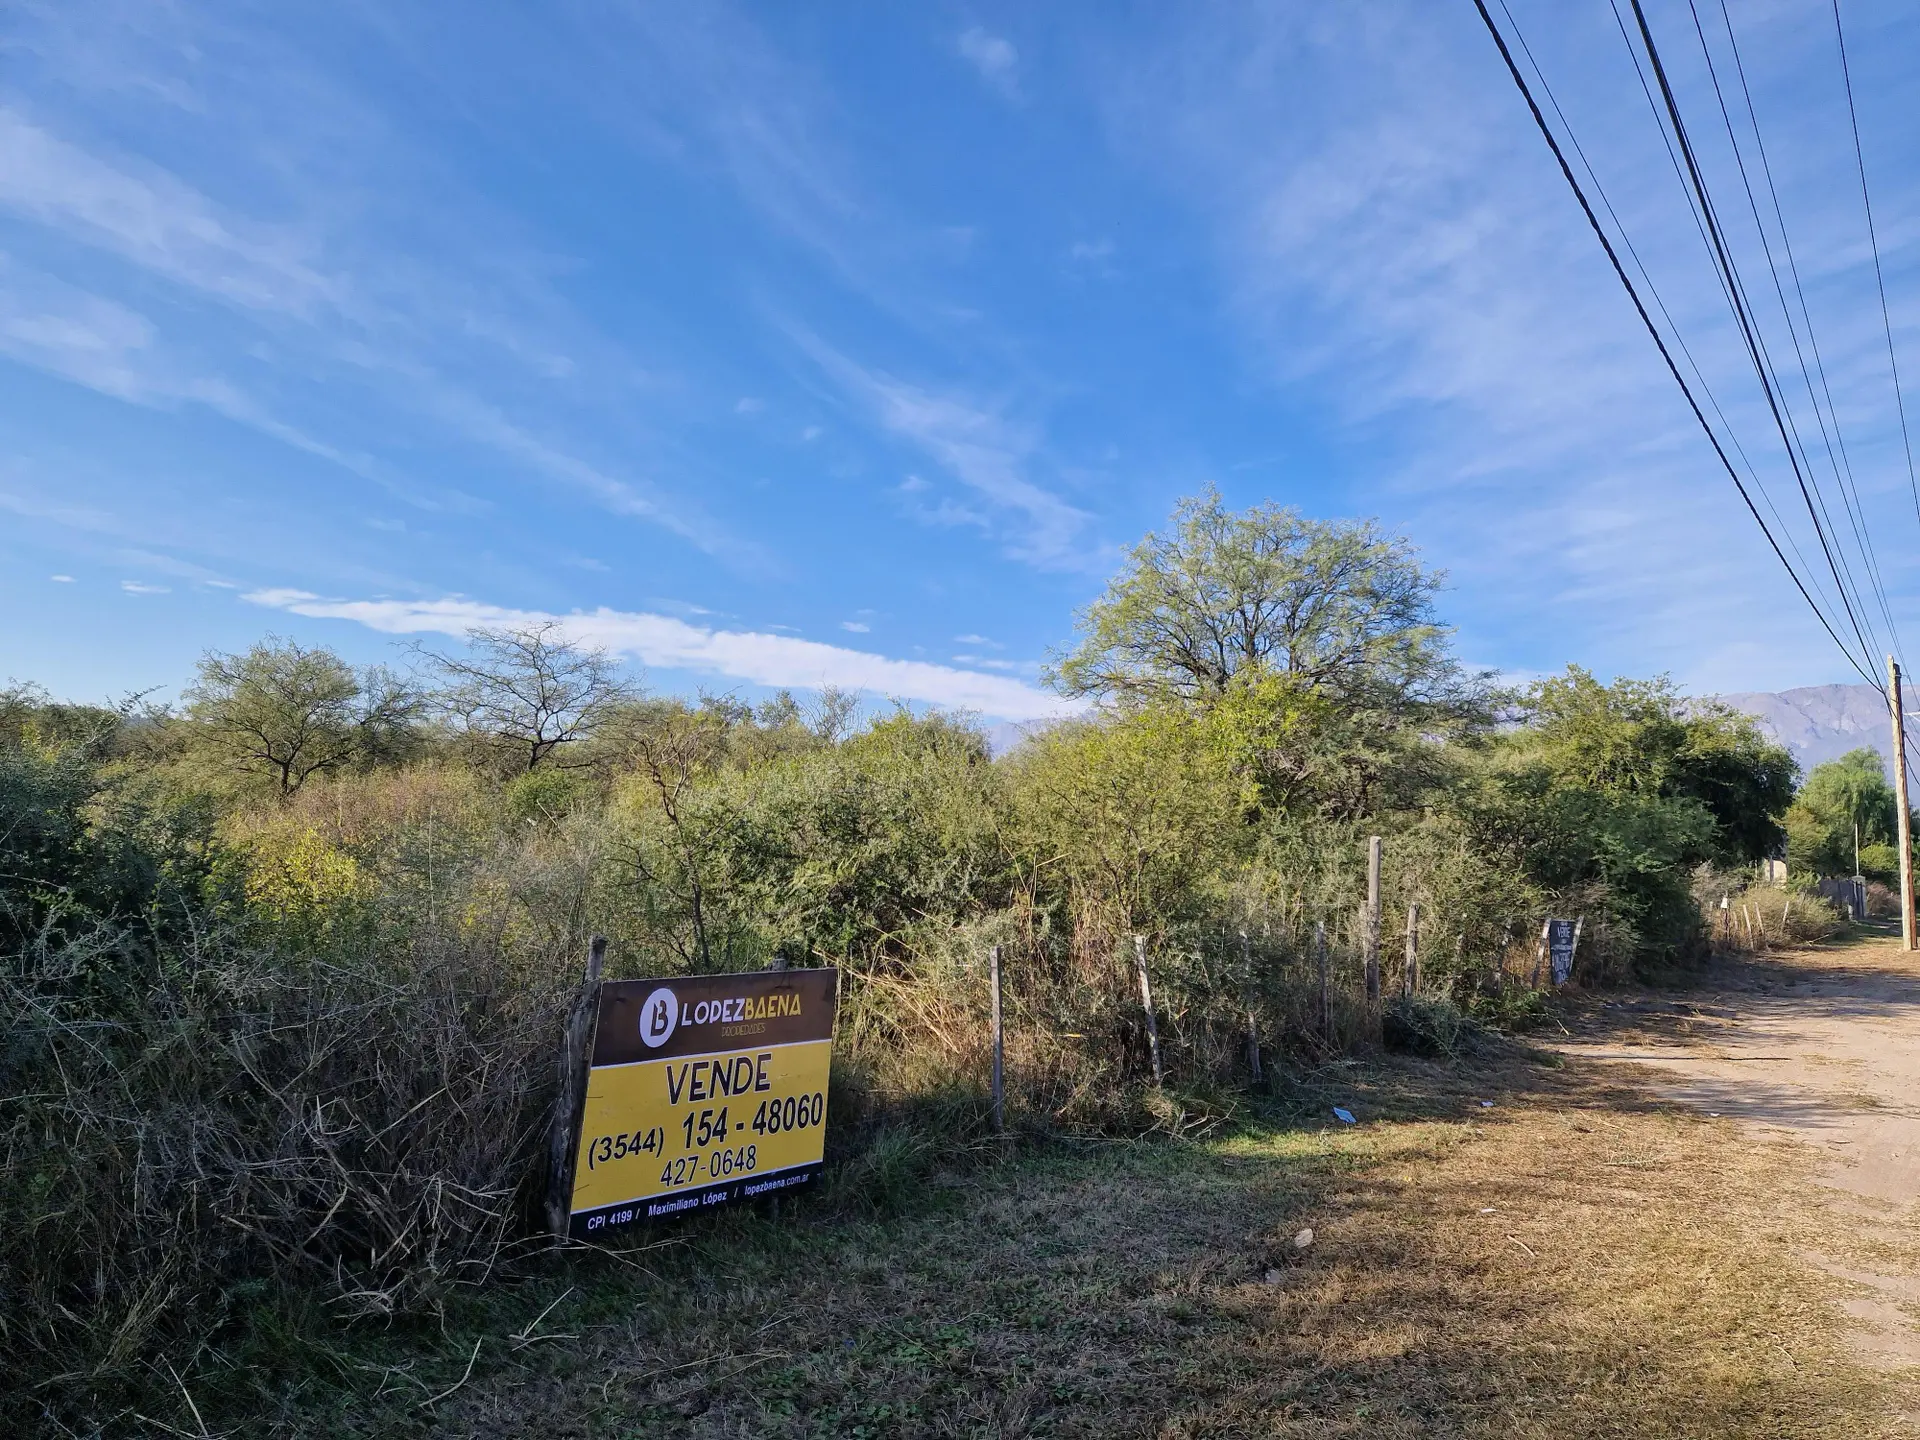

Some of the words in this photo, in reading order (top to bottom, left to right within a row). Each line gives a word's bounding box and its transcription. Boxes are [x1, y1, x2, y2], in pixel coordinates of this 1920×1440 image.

[666, 1053, 772, 1105] VENDE
[588, 1126, 665, 1170] (3544)
[682, 1106, 729, 1149] 154
[752, 1092, 824, 1136] 48060
[659, 1145, 757, 1187] 427-0648
[588, 1214, 606, 1230] CPI
[610, 1209, 633, 1225] 4199
[648, 1196, 699, 1217] Maximiliano
[702, 1191, 728, 1206] López
[744, 1173, 810, 1197] lopezbaena.com.ar
